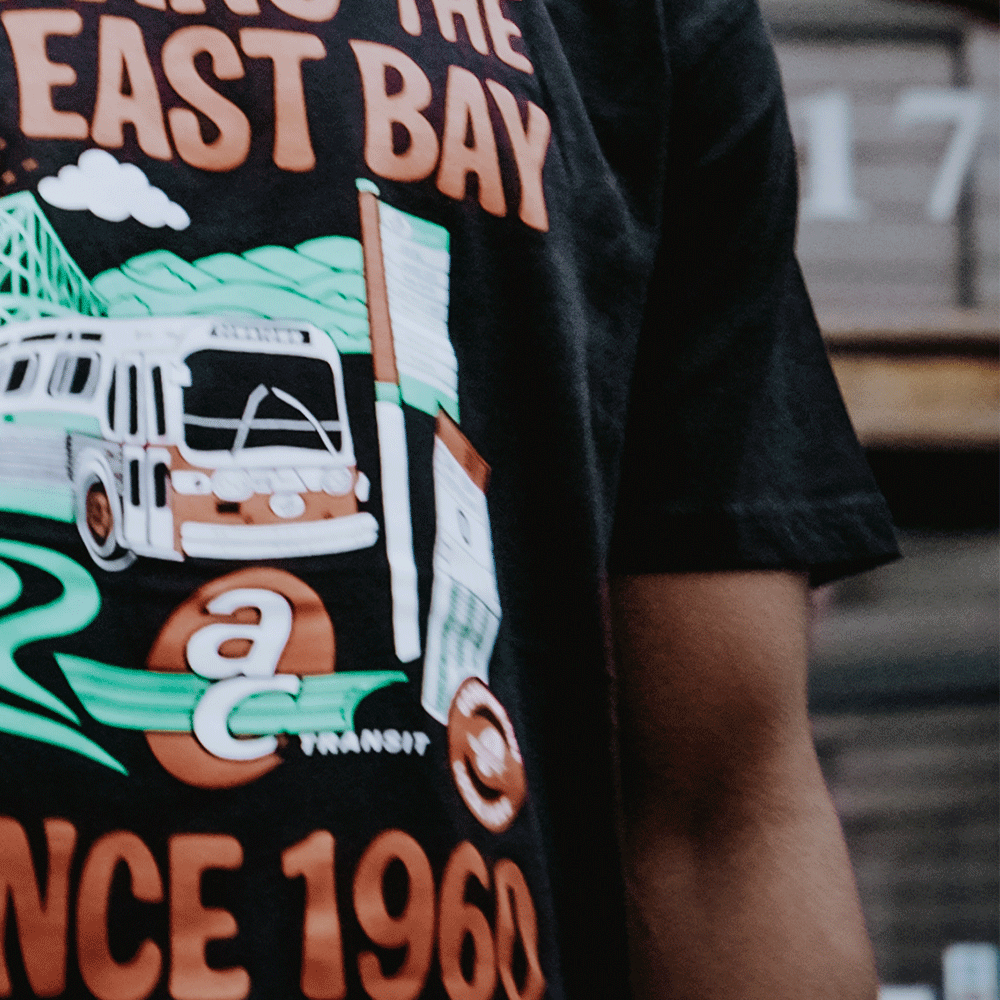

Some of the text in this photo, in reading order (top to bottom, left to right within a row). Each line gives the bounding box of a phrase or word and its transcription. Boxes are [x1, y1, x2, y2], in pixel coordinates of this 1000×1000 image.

[2, 8, 550, 232] EAST BAY
[300, 728, 431, 757] TRANSIT
[282, 829, 545, 1000] 1960
